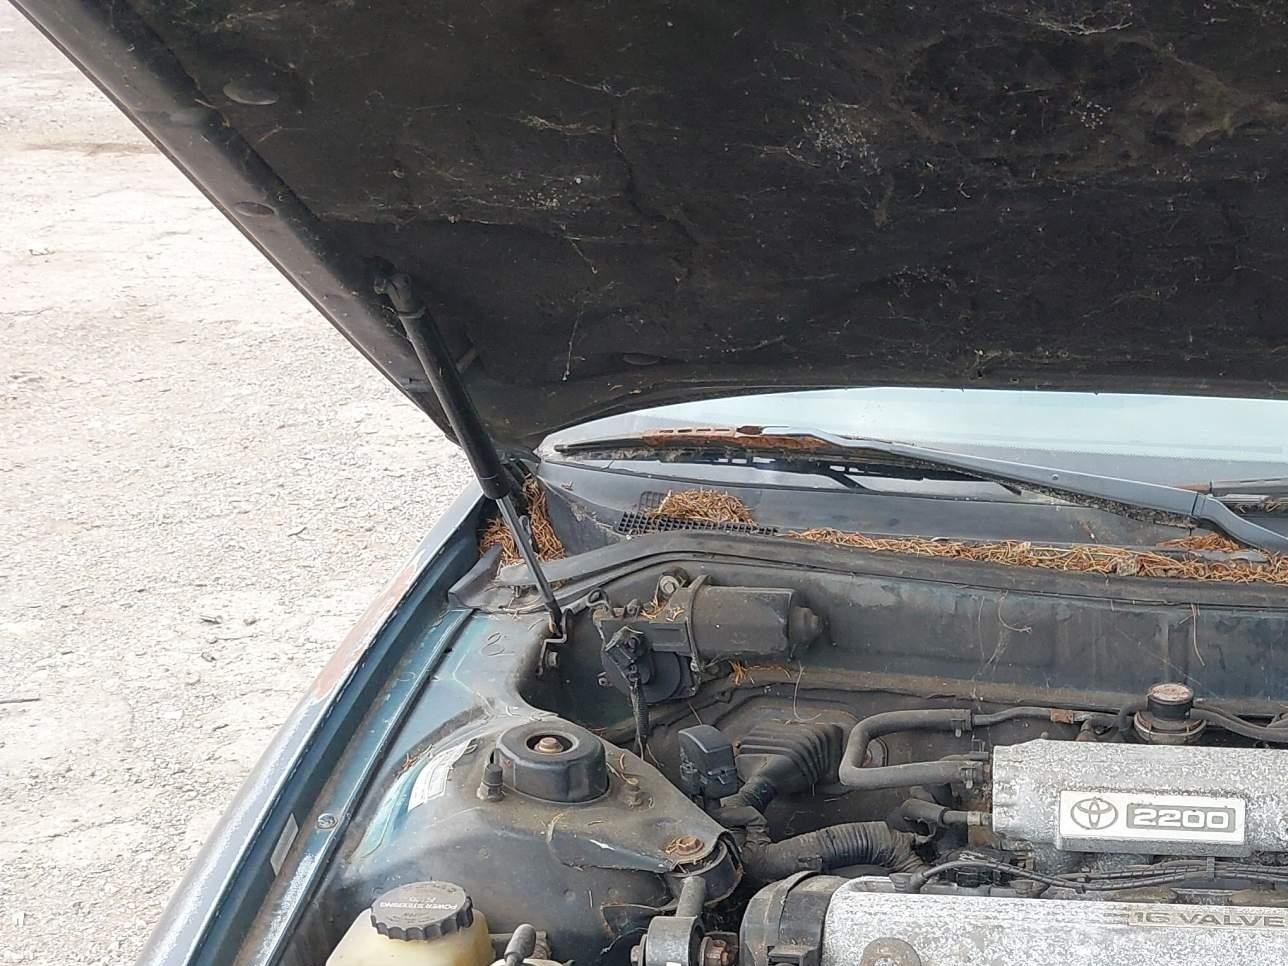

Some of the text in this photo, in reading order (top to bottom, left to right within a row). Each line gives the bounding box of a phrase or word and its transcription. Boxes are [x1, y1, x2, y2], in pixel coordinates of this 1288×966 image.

[1133, 807, 1229, 828] 2200
[1134, 911, 1285, 928] 16 VALVE
